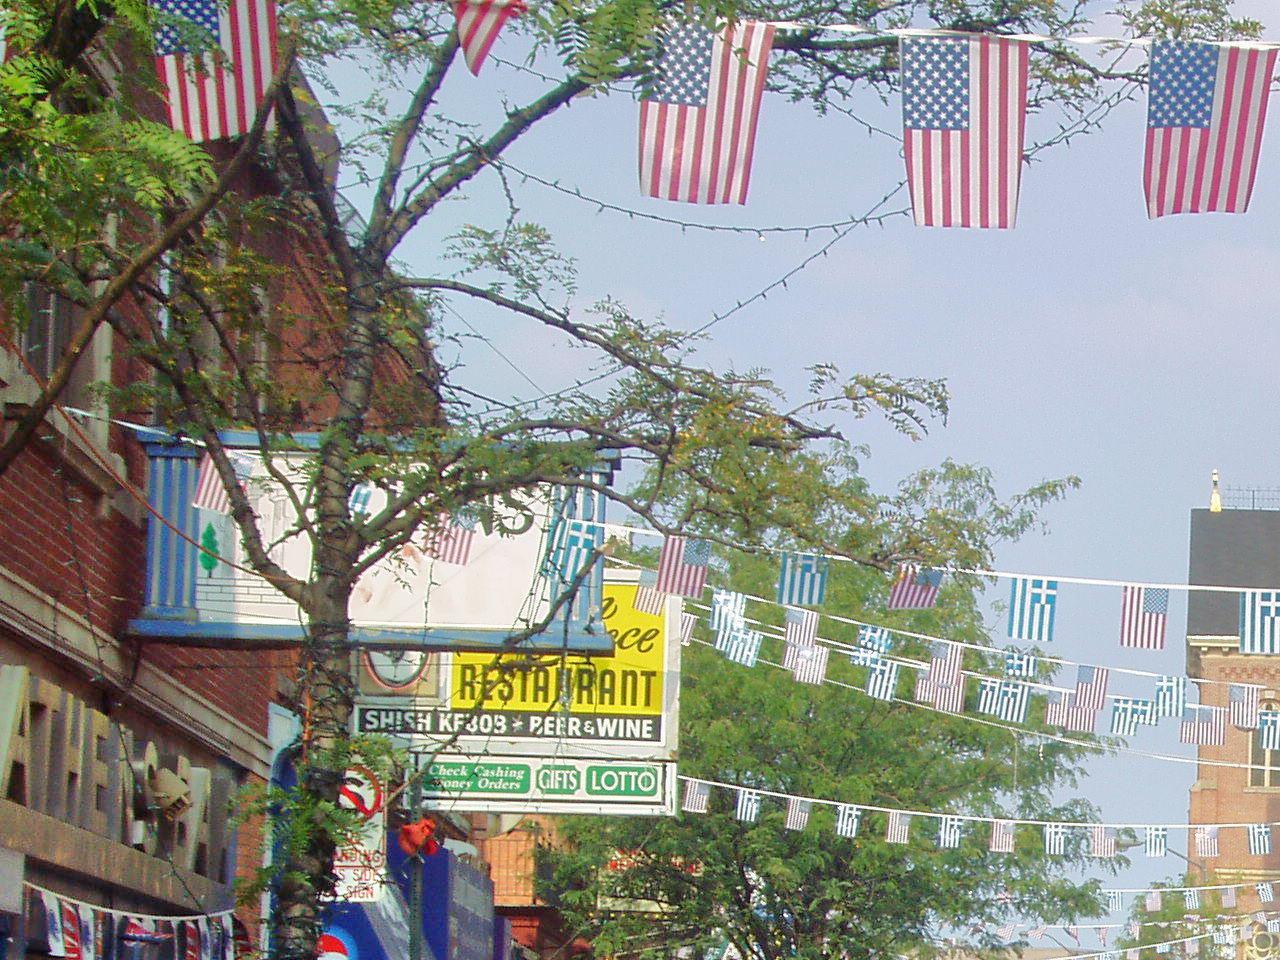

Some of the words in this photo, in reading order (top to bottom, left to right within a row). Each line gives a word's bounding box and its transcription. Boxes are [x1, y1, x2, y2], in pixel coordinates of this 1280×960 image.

[478, 778, 521, 791] Orders
[538, 768, 578, 791] GIFTS
[592, 770, 656, 792] LOTTO
